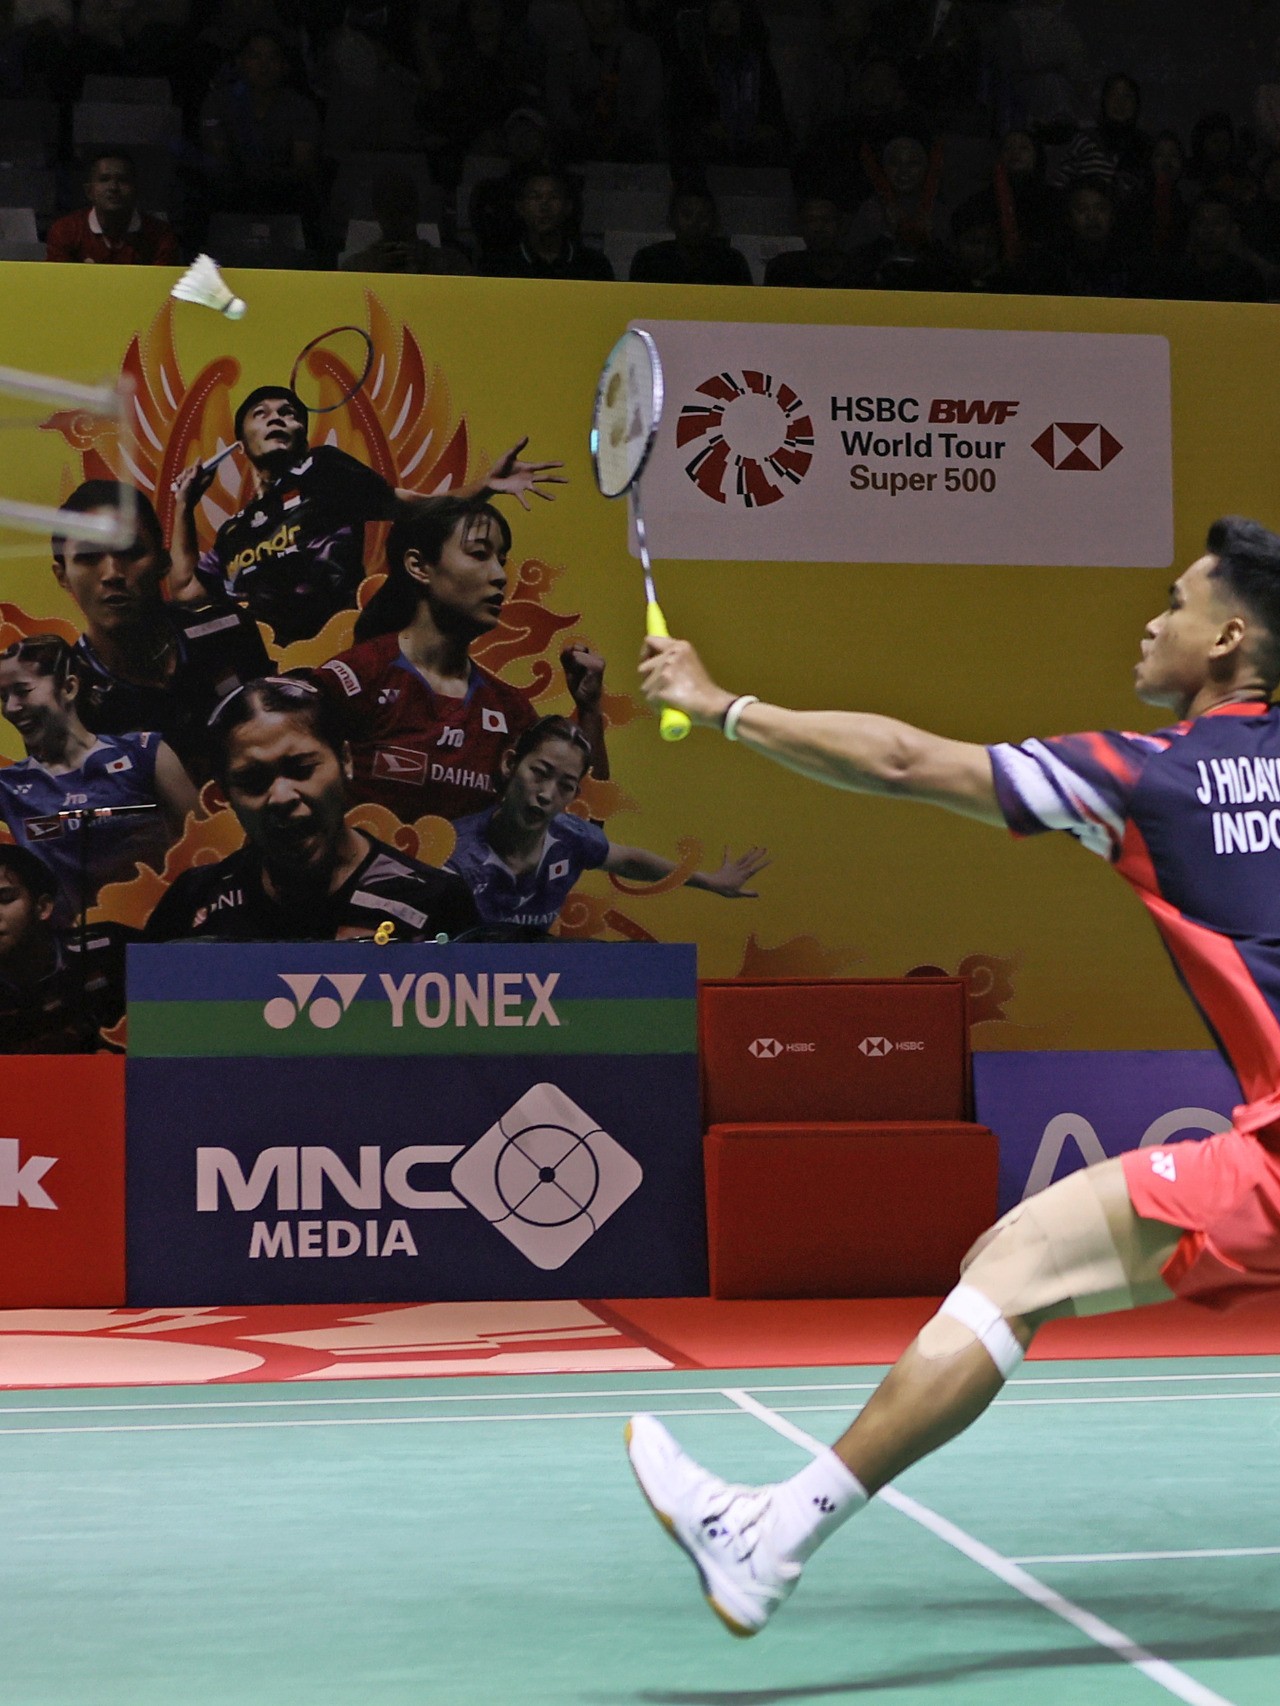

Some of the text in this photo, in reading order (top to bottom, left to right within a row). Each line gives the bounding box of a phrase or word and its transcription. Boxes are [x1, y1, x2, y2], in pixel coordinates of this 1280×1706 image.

[831, 396, 1020, 425] HSBC BWF
[841, 430, 1006, 459] World Tour
[850, 464, 996, 496] Super 500
[431, 763, 497, 793] DAIHAT
[1196, 760, 1212, 805] J
[380, 972, 562, 1028] YONEX
[786, 1042, 816, 1052] HSBC
[895, 1041, 925, 1051] HSBC
[196, 1144, 467, 1211] MNC
[248, 1219, 419, 1258] MEDIA
